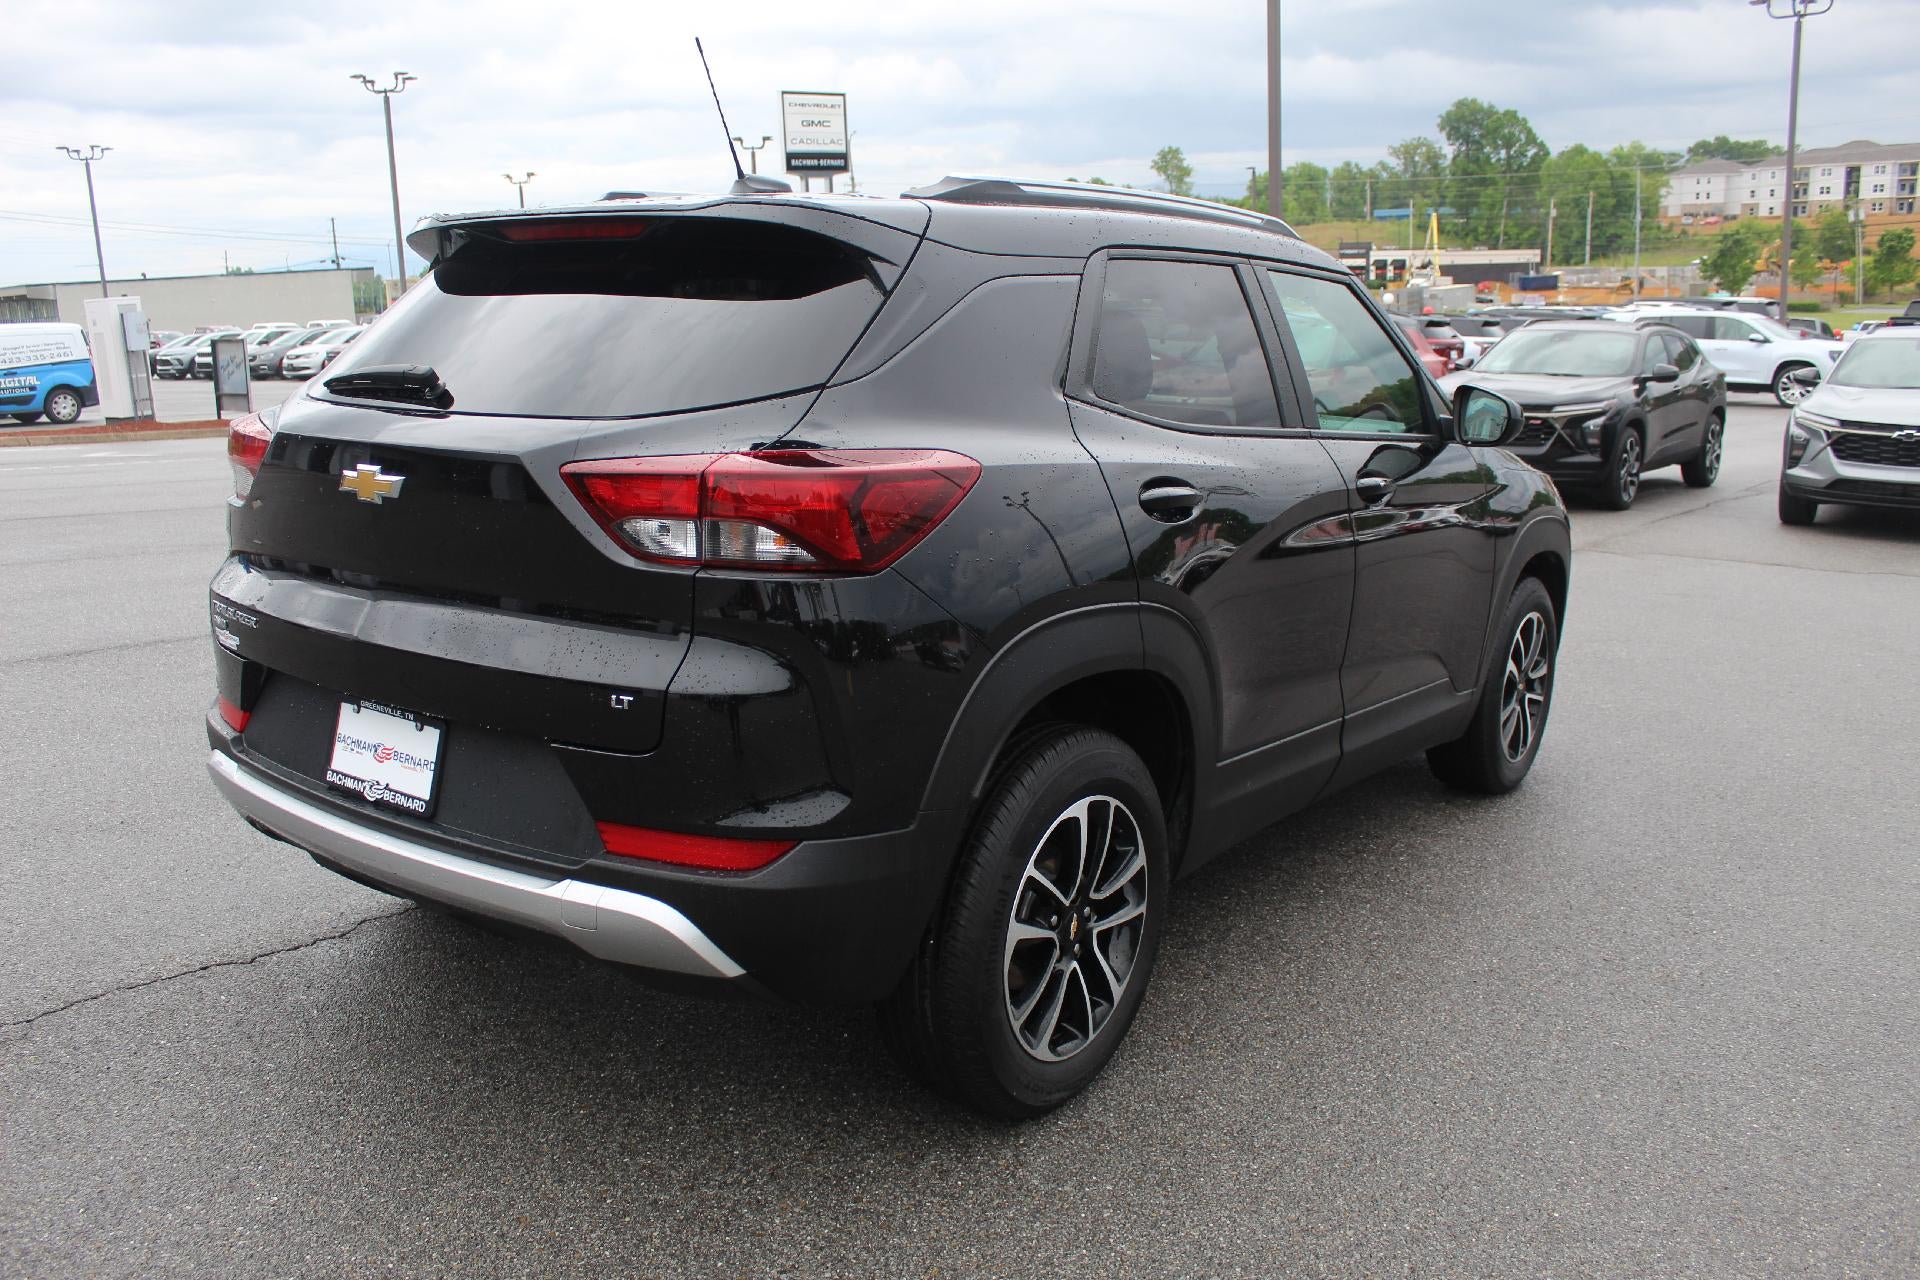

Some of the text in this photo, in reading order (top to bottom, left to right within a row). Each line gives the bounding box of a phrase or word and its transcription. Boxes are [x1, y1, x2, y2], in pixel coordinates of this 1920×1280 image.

[790, 138, 844, 146] CADILLAC
[611, 694, 633, 709] LT
[404, 712, 414, 720] TN
[336, 732, 375, 754] BACHMAN
[393, 751, 435, 772] BERNARD
[326, 771, 426, 812] BACHMAN BERNARD
